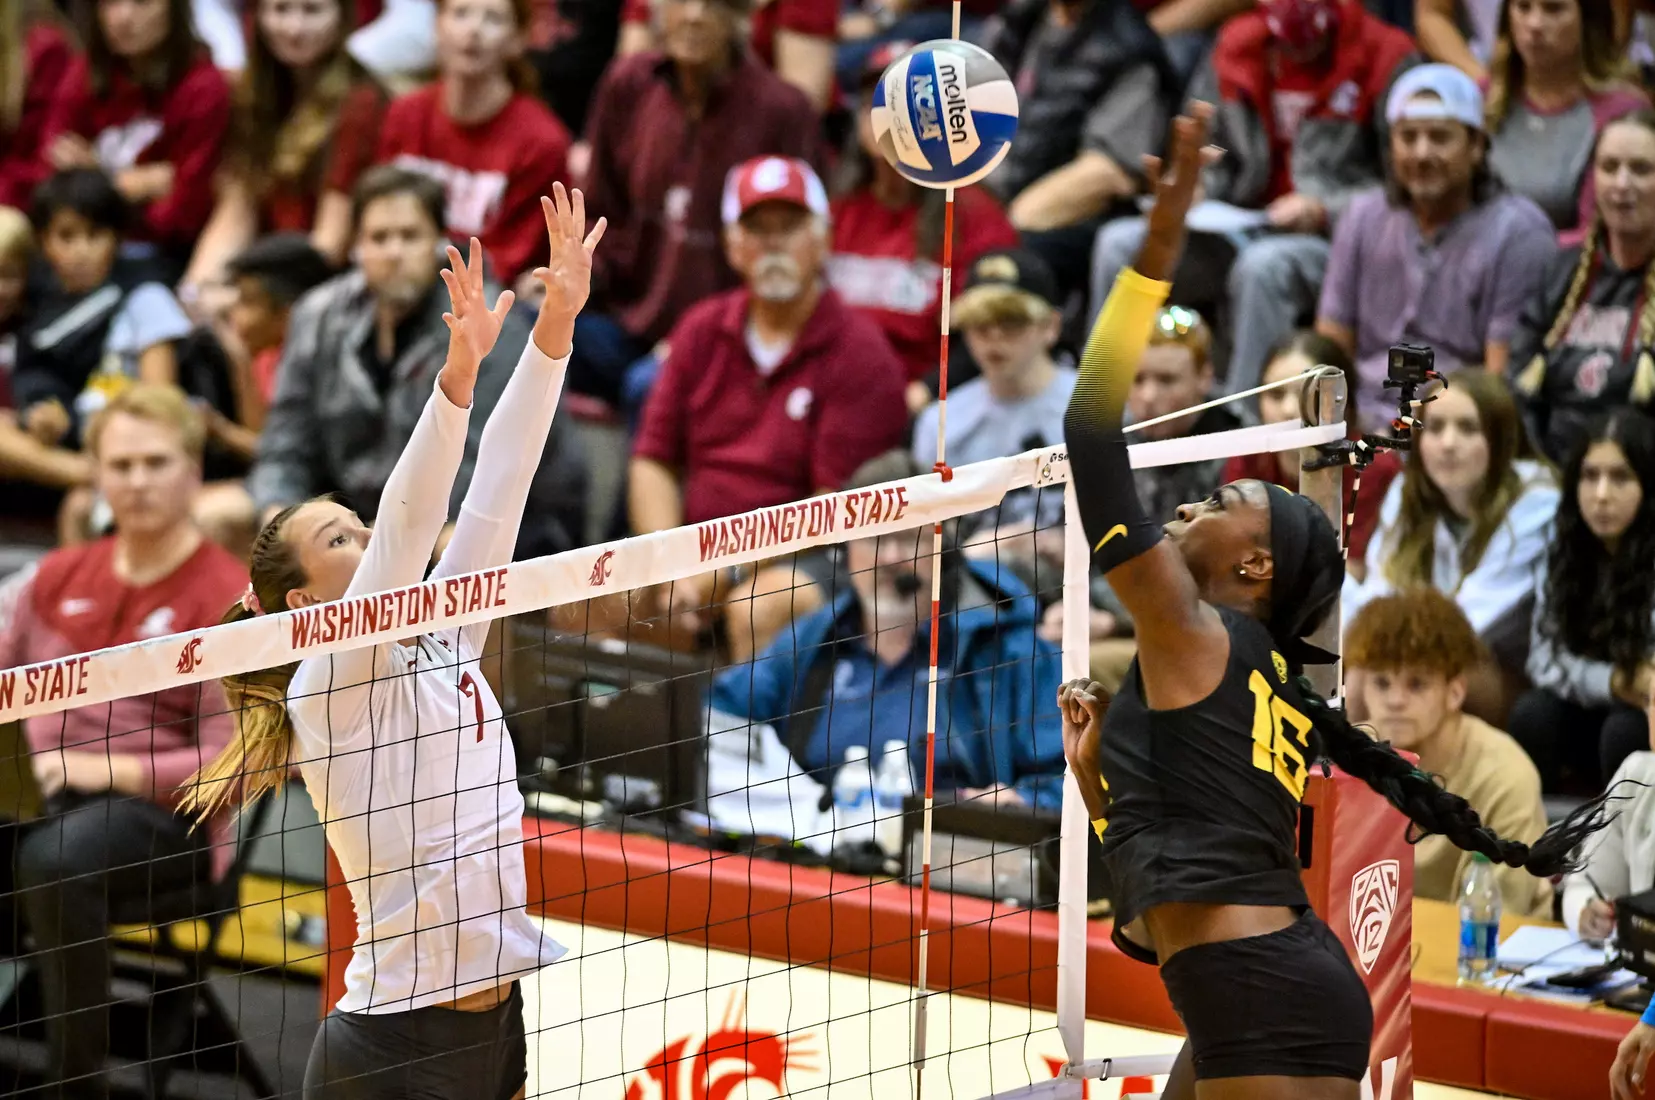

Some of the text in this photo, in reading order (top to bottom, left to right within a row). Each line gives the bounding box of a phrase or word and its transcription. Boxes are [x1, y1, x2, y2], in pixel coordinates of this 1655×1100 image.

[911, 74, 942, 141] NCAA
[940, 65, 967, 143] molten
[698, 486, 909, 562] WASHINGTON STATE
[290, 568, 508, 649] WASHINGTON STATE
[24, 655, 91, 706] STATE
[1248, 669, 1313, 803] 16
[1352, 864, 1397, 936] PAC
[1363, 919, 1382, 954] 12
